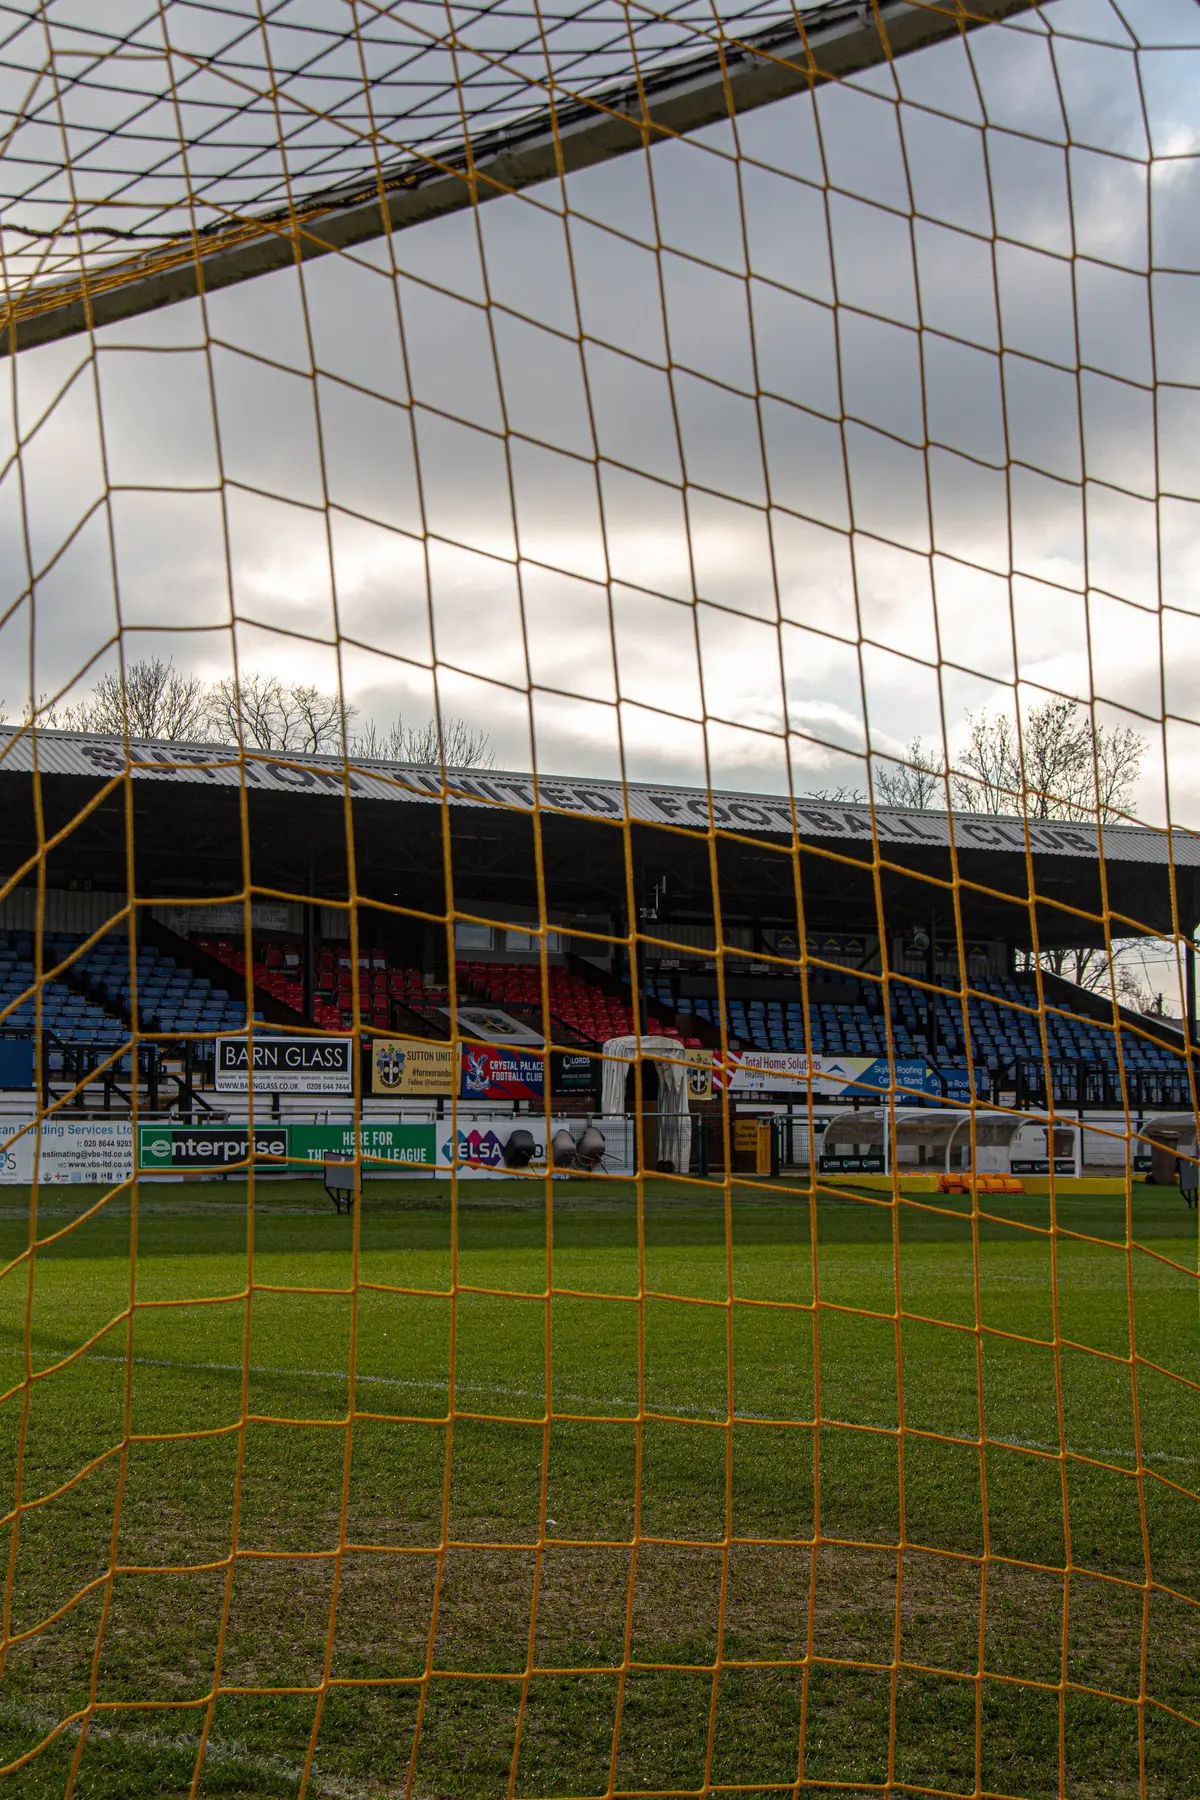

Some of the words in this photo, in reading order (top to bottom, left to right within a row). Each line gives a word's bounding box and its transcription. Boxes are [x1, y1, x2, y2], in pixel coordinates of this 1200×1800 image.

[81, 746, 363, 791] SUTTON
[392, 773, 620, 813] UNITED
[650, 796, 943, 841] FOOTBALL
[961, 823, 1098, 852] CLUB
[226, 1046, 278, 1065] BARN
[285, 1047, 343, 1067] GLASS
[407, 1051, 434, 1061] SUTTON
[435, 1052, 459, 1062] UNITD
[571, 1056, 591, 1064] LORDS
[489, 1060, 519, 1071] CRYSTAL
[520, 1061, 545, 1071] PALACE
[745, 1056, 762, 1069] Total
[763, 1057, 787, 1069] Home
[787, 1057, 822, 1070] Solutns
[412, 1068, 454, 1078] #foreveramb
[874, 1065, 896, 1075] Skyli
[896, 1065, 923, 1075] Roofing
[491, 1071, 525, 1082] FOOTBALL
[526, 1072, 543, 1082] CLUB
[878, 1076, 902, 1085] Cenes
[903, 1076, 923, 1085] Stand
[218, 1082, 299, 1090] WWW.BANGLASS.CO.UK
[307, 1082, 322, 1090] 0208
[931, 1079, 953, 1088] Skyne
[954, 1080, 978, 1090] Roofg
[935, 1090, 959, 1098] Ctres
[19, 1124, 64, 1137] Buiding
[67, 1124, 114, 1135] Services
[343, 1131, 370, 1146] HERE
[372, 1131, 393, 1146] FOR
[42, 1150, 132, 1159] estimating@vbs-ltd.co.uk
[150, 1137, 285, 1161] enterprise
[387, 1147, 427, 1162] LEAGUE
[446, 1142, 502, 1159] TELSA
